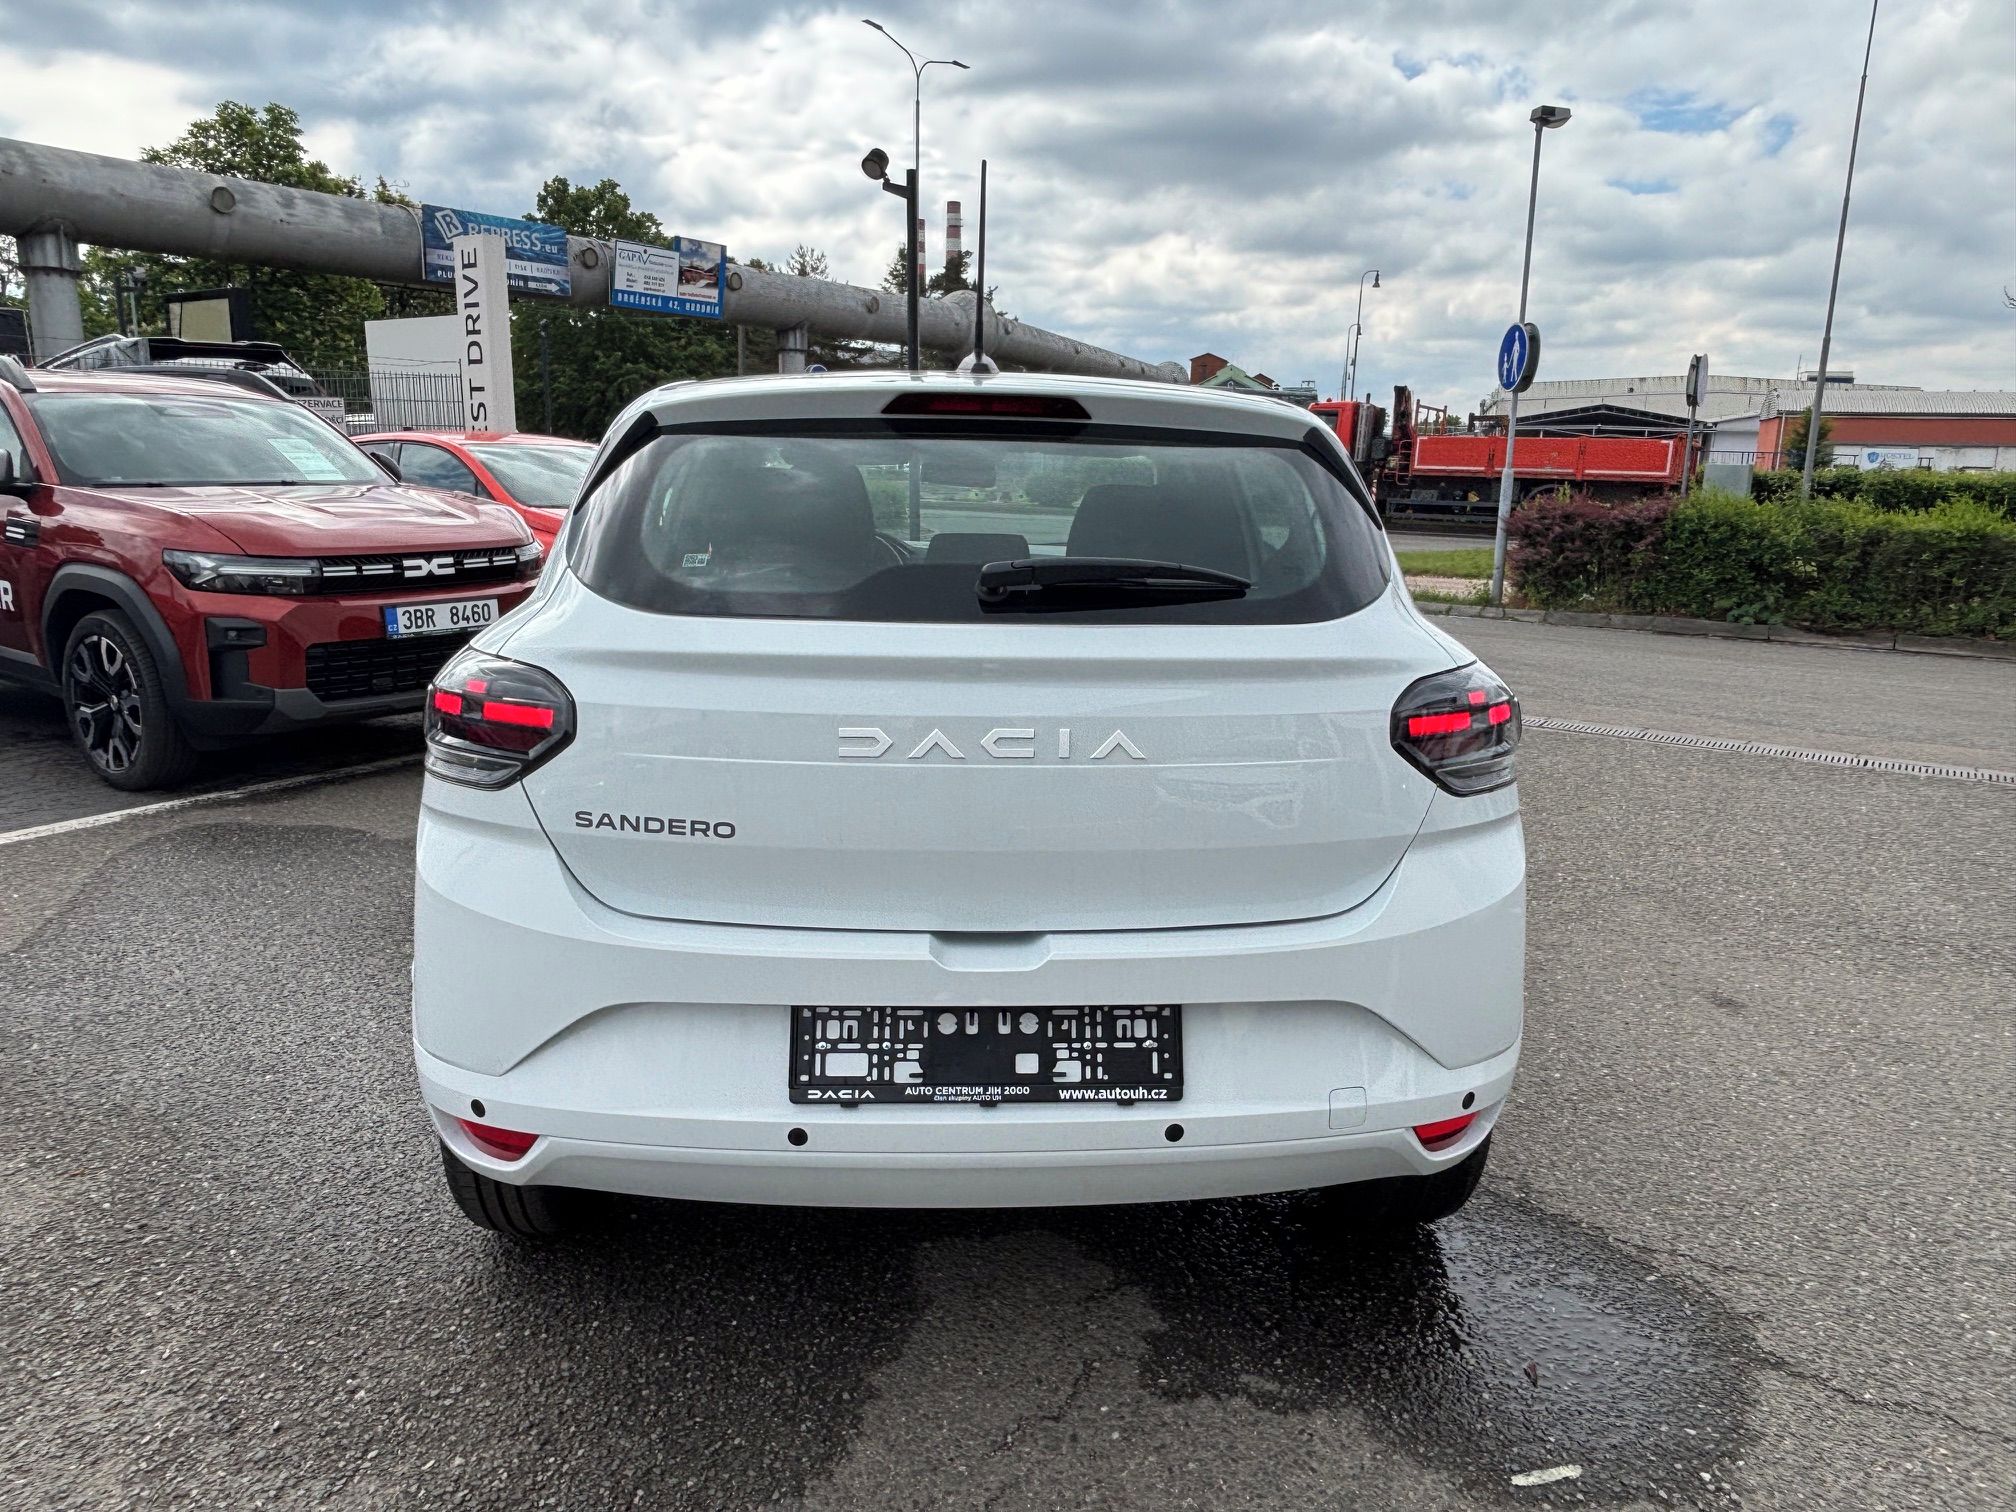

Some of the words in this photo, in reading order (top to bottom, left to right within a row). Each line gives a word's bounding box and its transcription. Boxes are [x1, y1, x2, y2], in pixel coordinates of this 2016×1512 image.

[461, 247, 484, 366] DRIVE
[402, 608, 436, 631] 3BR
[450, 603, 491, 625] 8460
[838, 727, 1147, 759] DACIA
[574, 810, 736, 839] SANDERO
[807, 1089, 876, 1099] DACIA
[904, 1086, 932, 1095] AUTO
[935, 1086, 983, 1095] CENTRUM
[986, 1086, 1001, 1095] JIH
[1004, 1086, 1030, 1095] 2000
[1059, 1086, 1167, 1100] www.autouh.cz
